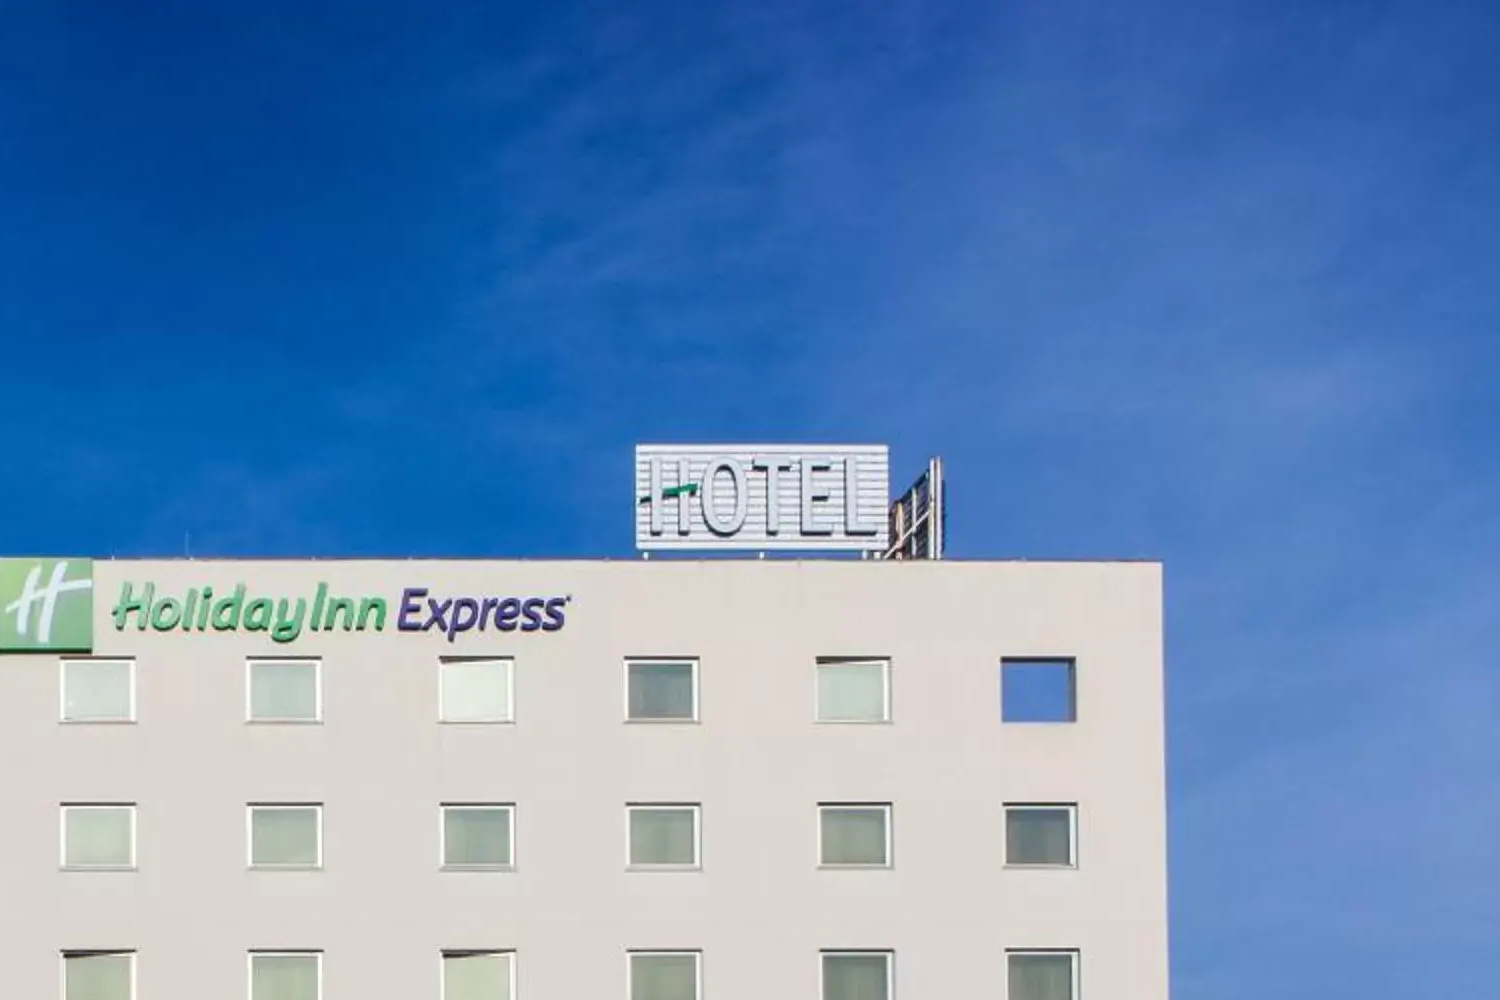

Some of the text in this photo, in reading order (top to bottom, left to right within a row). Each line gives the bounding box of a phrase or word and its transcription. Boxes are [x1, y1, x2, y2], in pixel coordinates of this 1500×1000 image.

[639, 456, 878, 537] HOTEL
[111, 581, 568, 642] Holiday Inn Express
